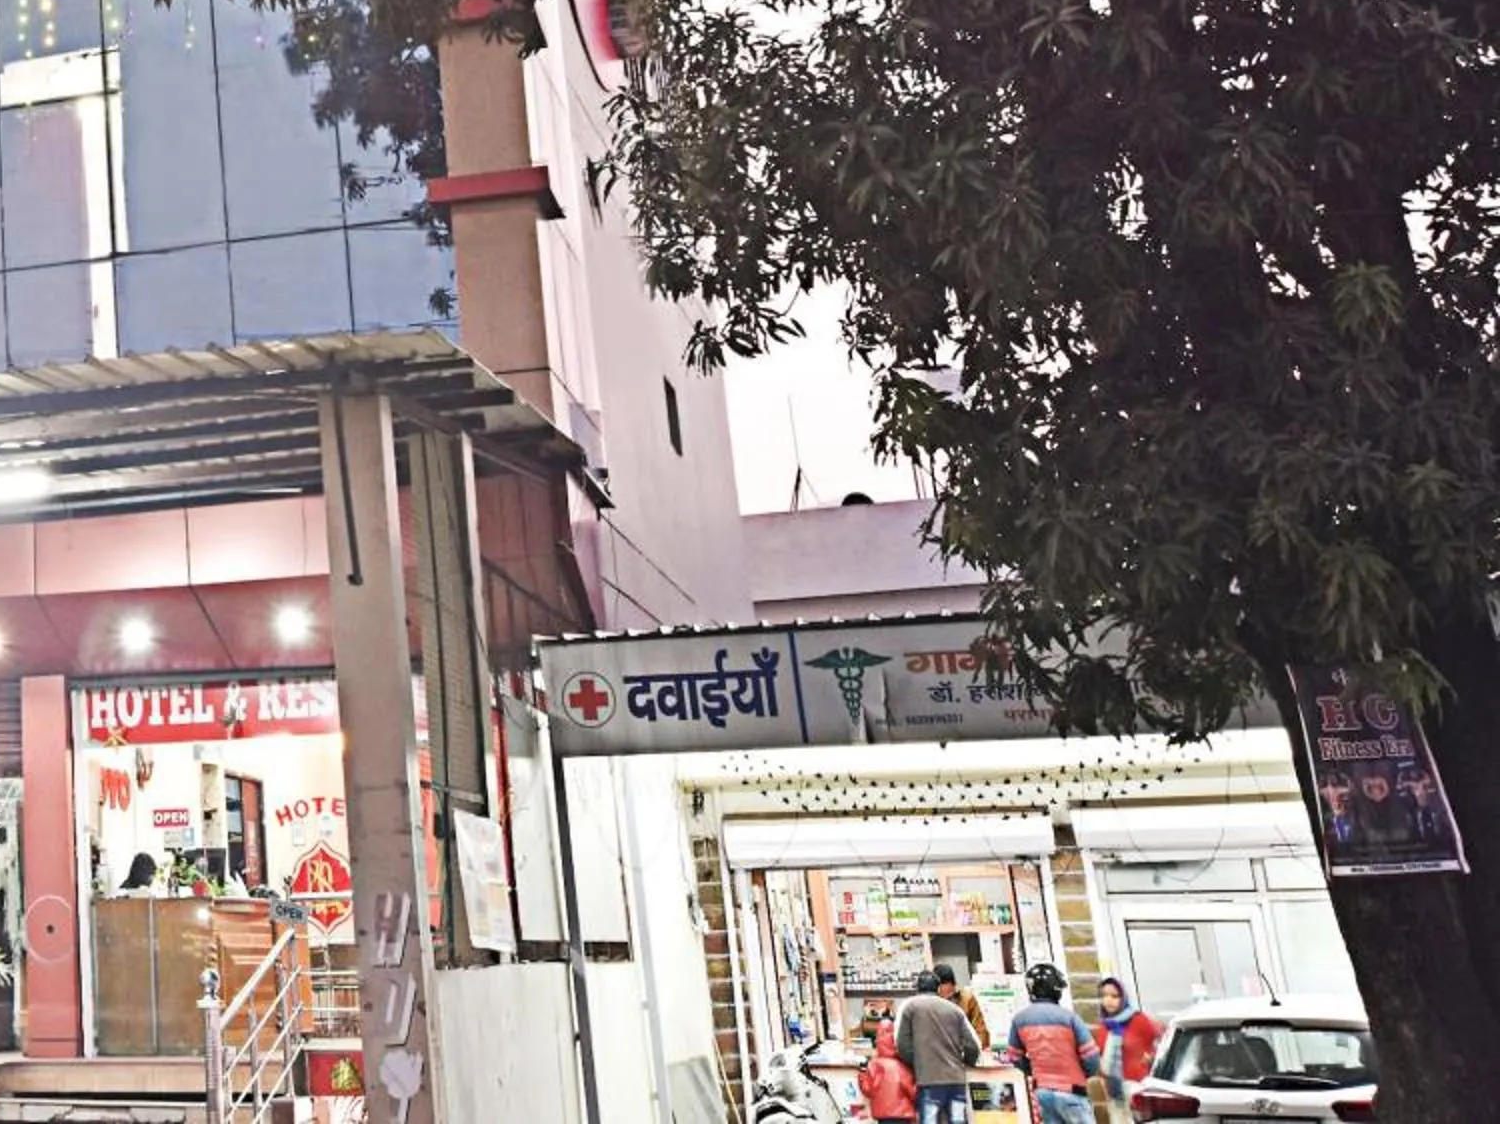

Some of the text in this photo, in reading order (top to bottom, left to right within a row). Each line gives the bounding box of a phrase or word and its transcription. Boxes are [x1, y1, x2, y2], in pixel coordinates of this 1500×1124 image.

[91, 684, 213, 728] HOTEL
[258, 677, 336, 721] RES
[623, 647, 779, 728] दवाईयाँ
[155, 811, 187, 825] OPEN
[275, 796, 346, 826] HOTE
